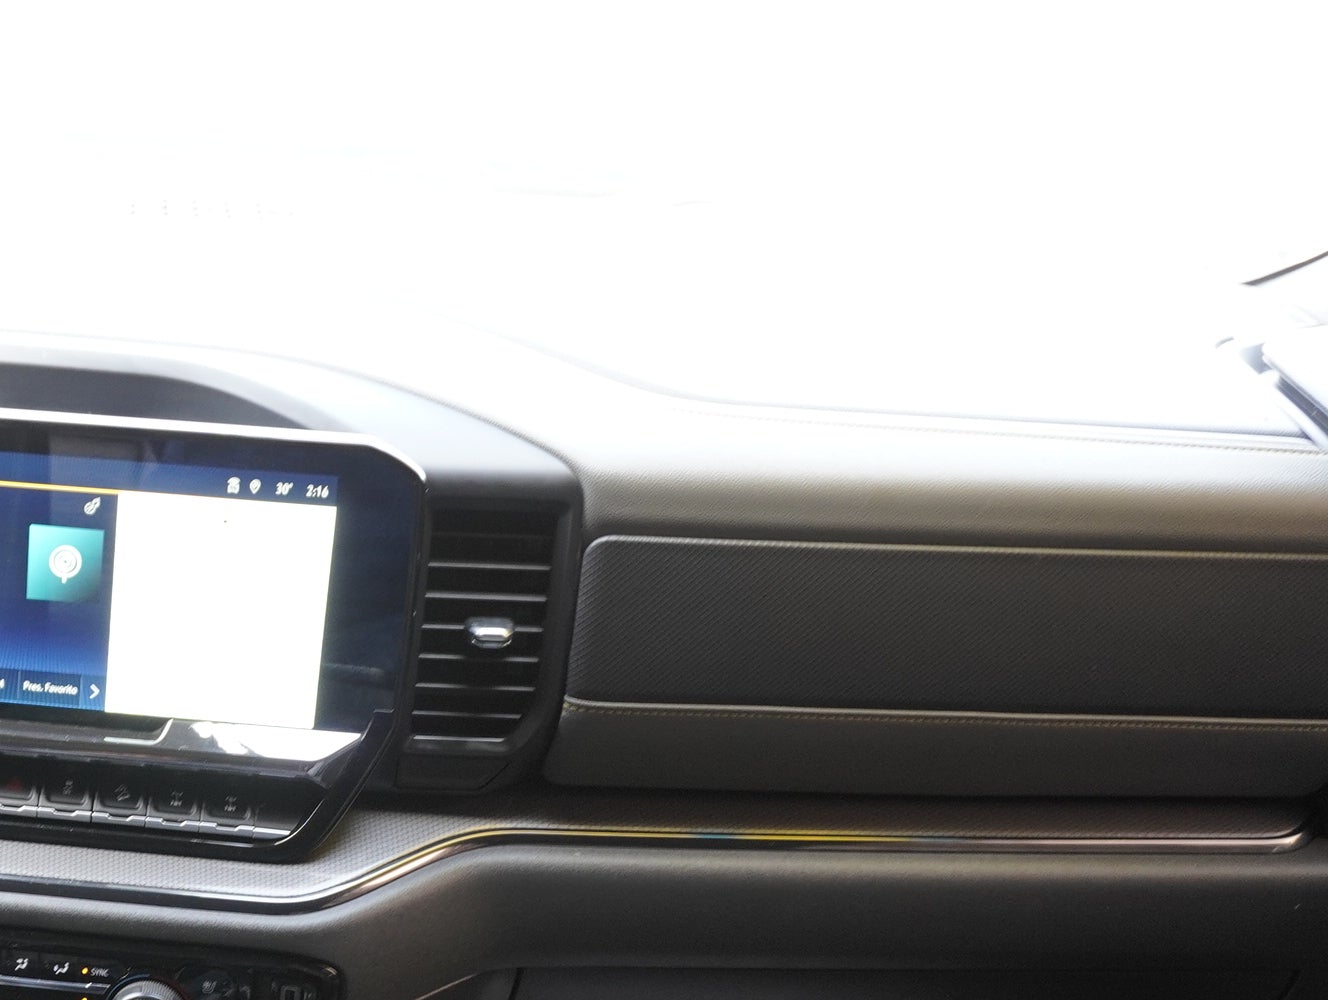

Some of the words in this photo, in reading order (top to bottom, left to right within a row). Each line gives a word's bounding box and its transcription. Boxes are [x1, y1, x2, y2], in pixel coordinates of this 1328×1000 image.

[306, 483, 329, 499] 2:16
[23, 680, 44, 693] Pres.
[44, 682, 78, 696] Favorito
[90, 968, 110, 978] SYNC
